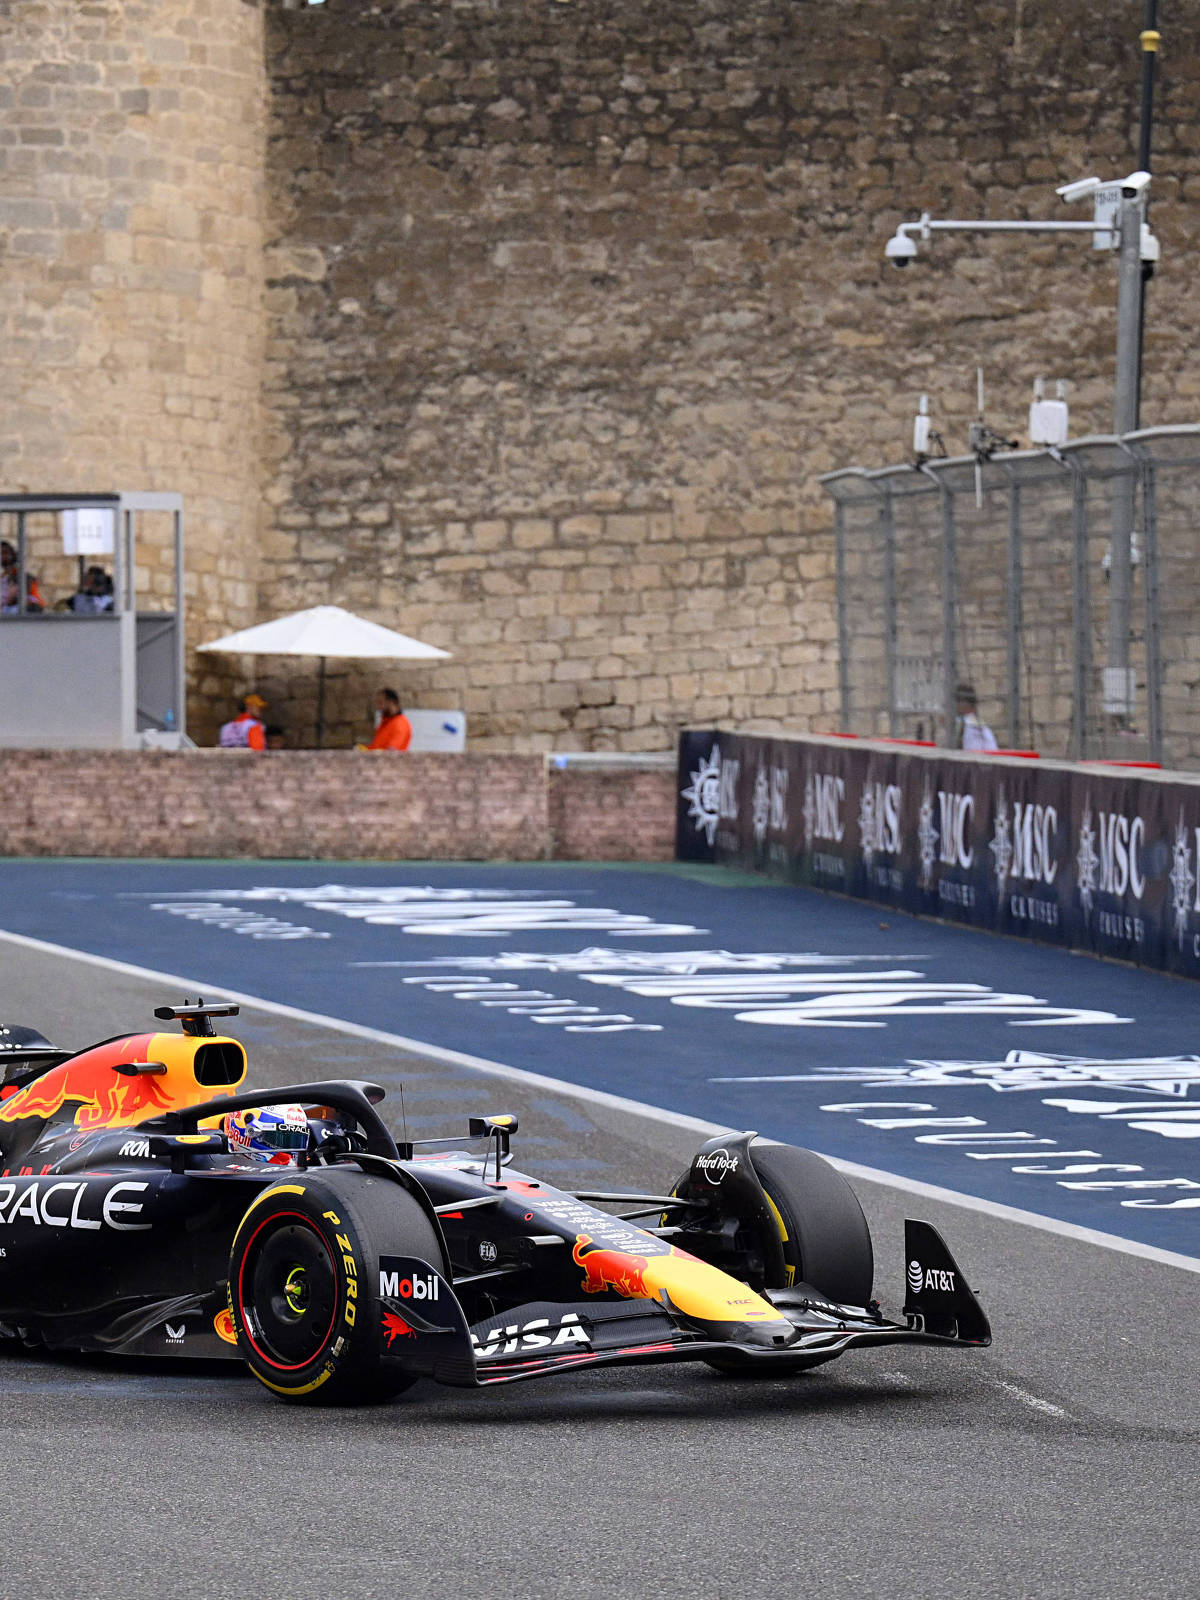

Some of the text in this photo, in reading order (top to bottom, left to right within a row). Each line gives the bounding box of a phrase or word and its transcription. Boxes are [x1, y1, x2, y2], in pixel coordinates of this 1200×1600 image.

[1011, 802, 1057, 884] MSC
[1099, 811, 1146, 899] MSC
[696, 1155, 719, 1169] Hard
[322, 1210, 341, 1226] P
[335, 1233, 358, 1327] ZERO
[480, 1244, 497, 1259] FIA
[379, 1271, 439, 1301] Mobil
[924, 1270, 956, 1292] AT&T
[470, 1312, 591, 1357] VISA
